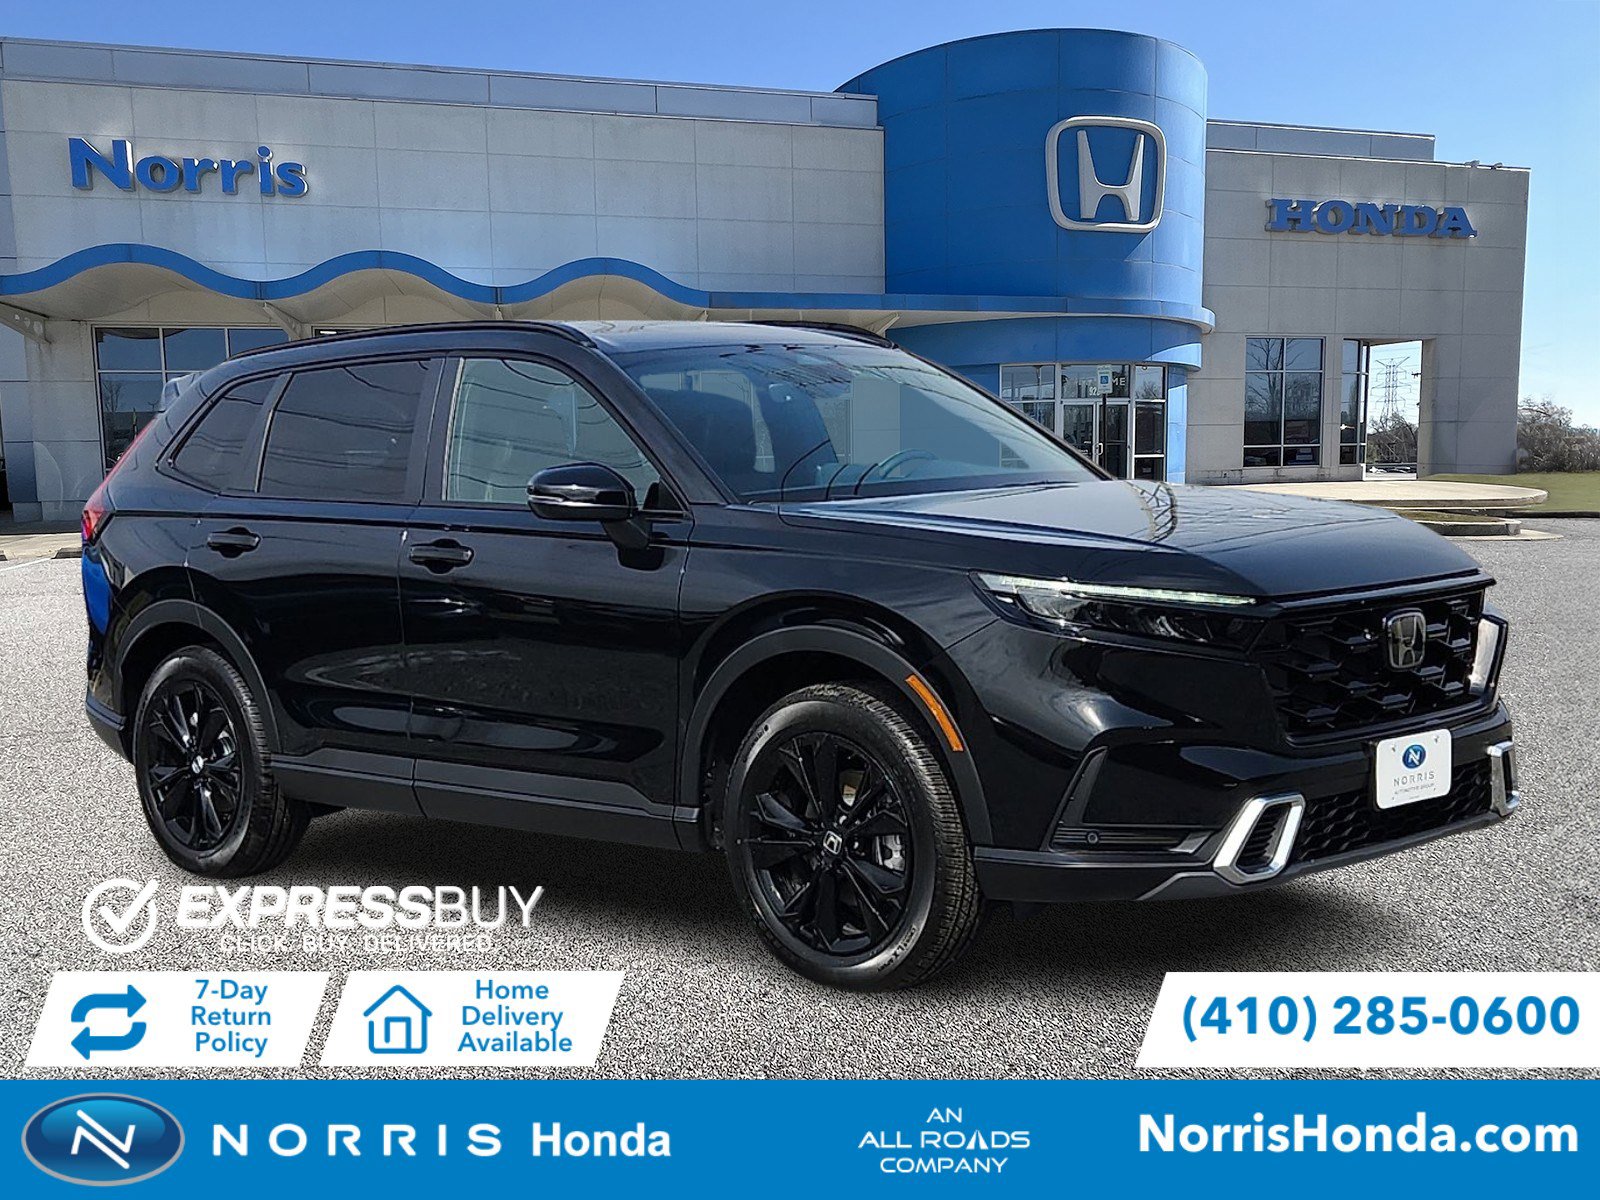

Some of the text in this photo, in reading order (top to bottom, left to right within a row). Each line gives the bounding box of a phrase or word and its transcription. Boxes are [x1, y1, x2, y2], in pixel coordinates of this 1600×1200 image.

[68, 137, 309, 198] Norris
[1265, 198, 1478, 239] HONDA
[1393, 770, 1436, 787] NORRIS
